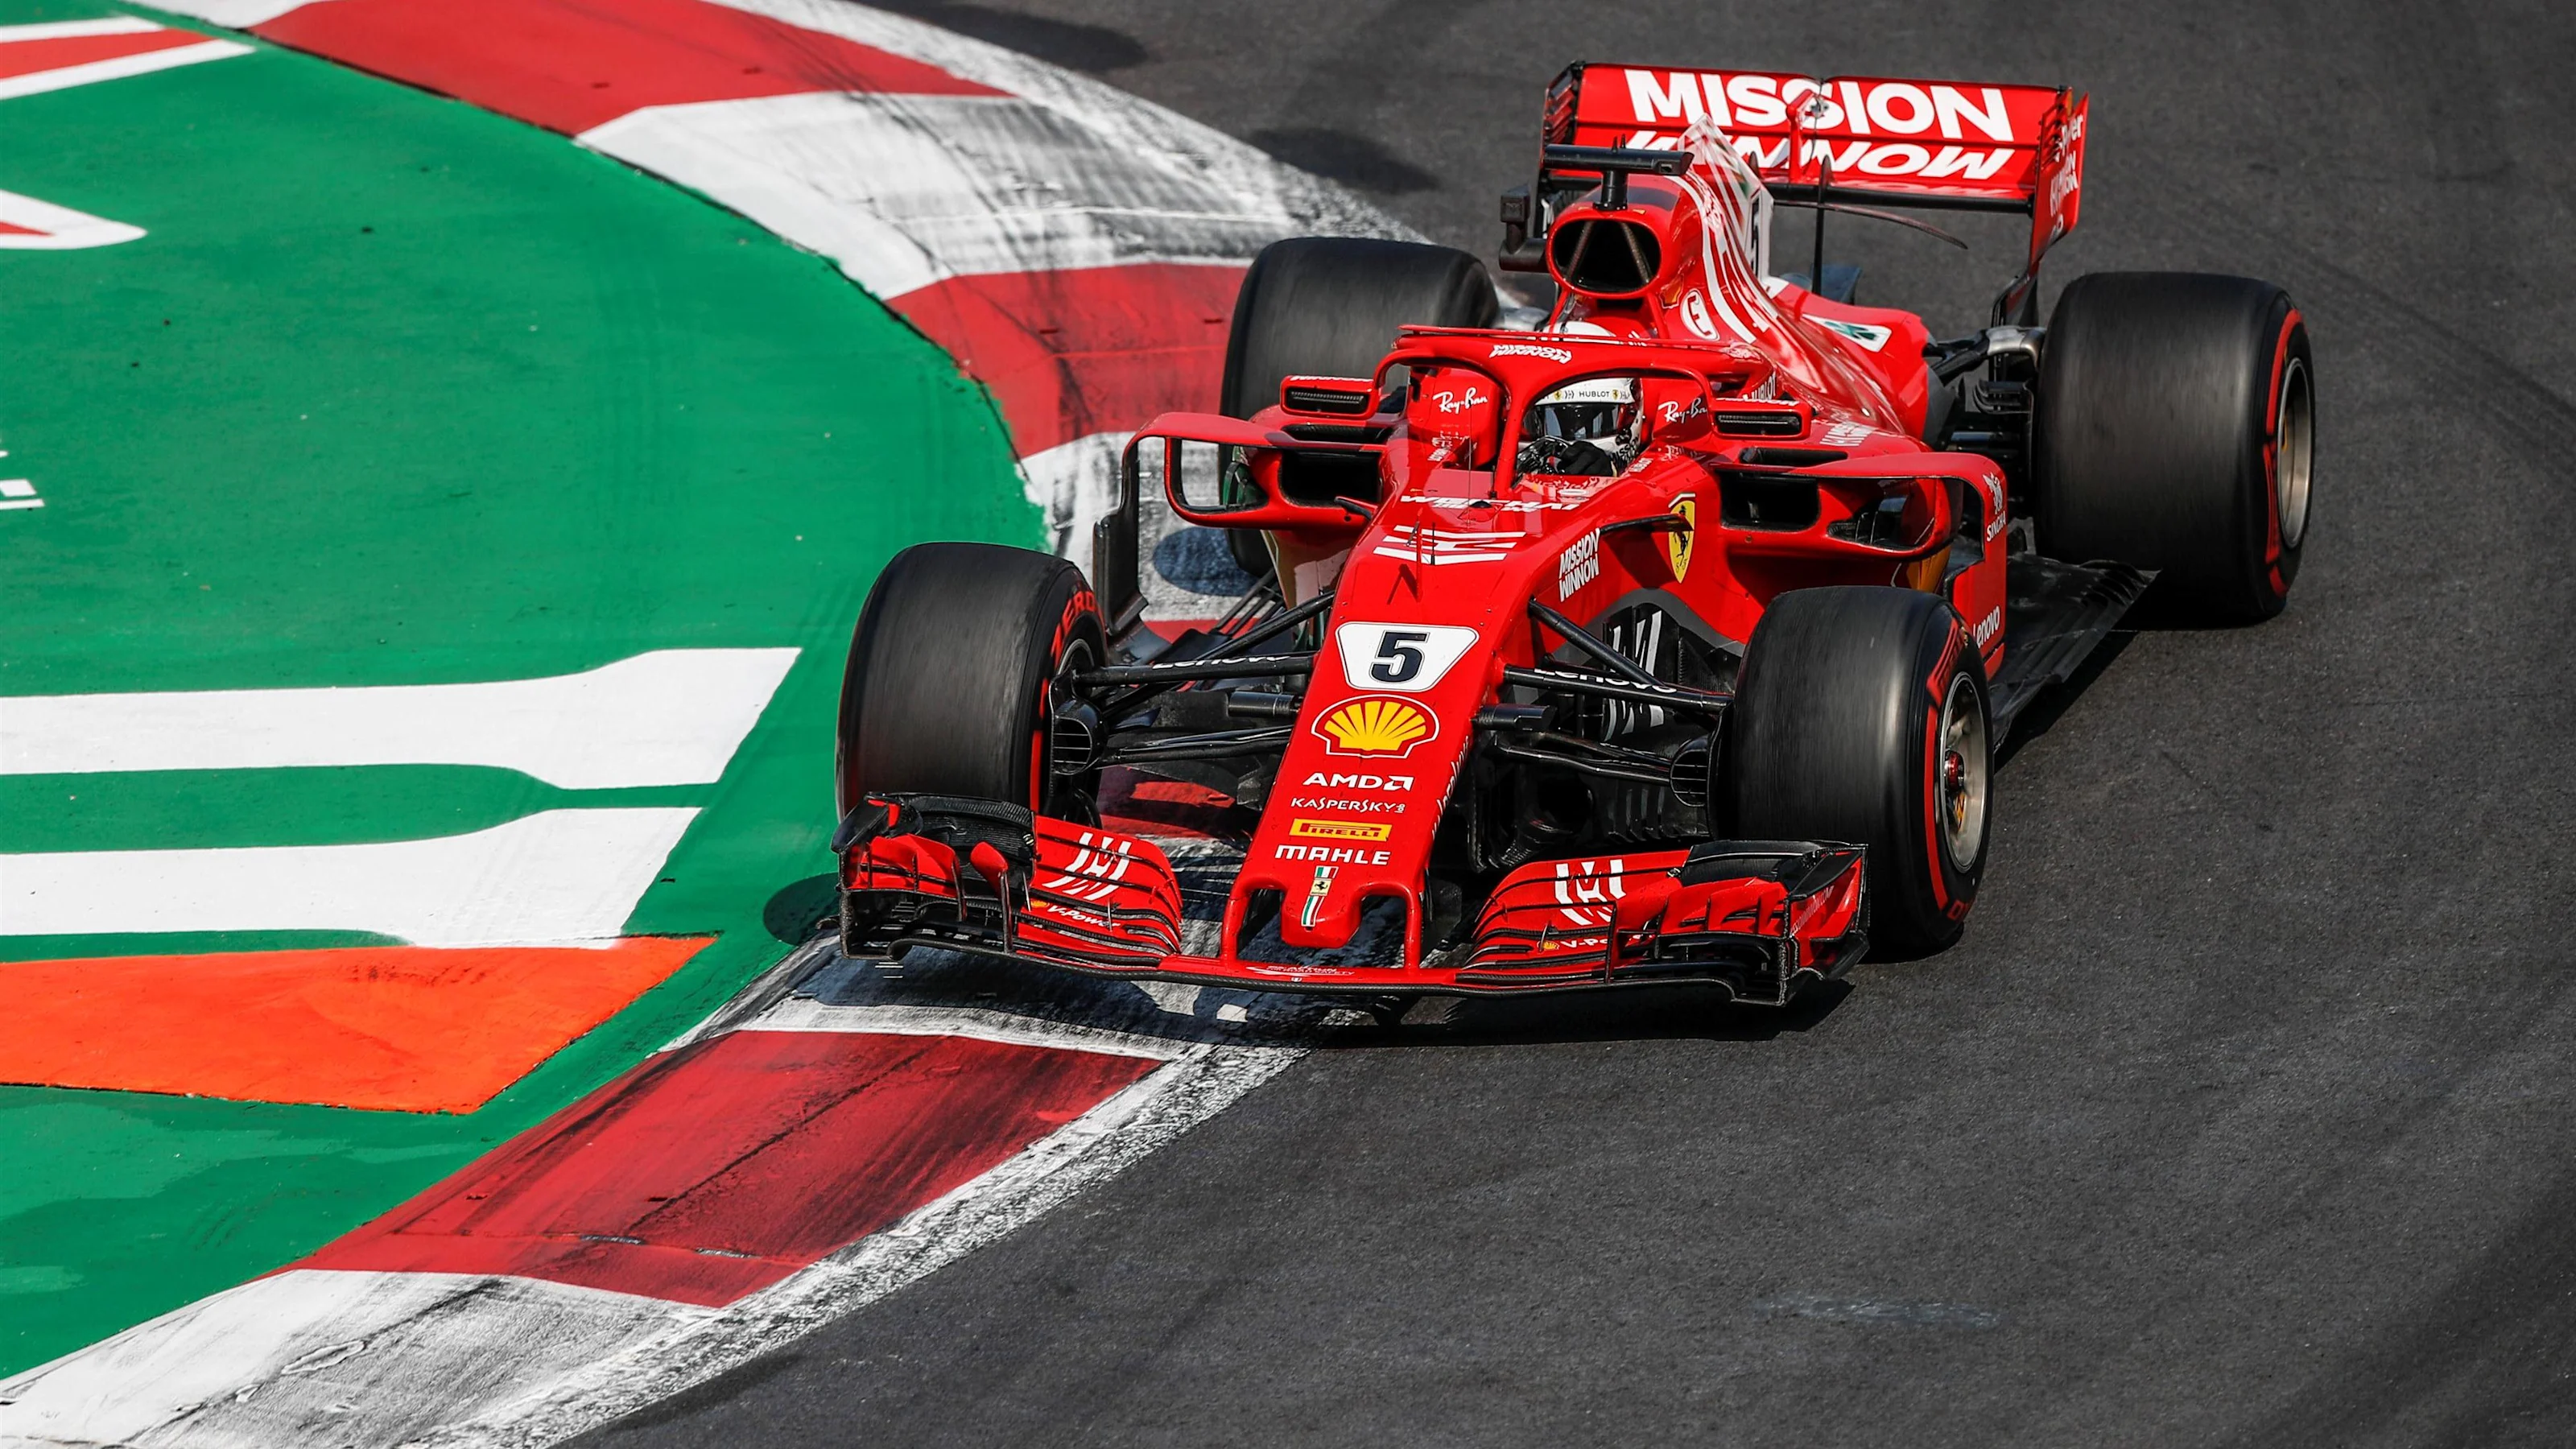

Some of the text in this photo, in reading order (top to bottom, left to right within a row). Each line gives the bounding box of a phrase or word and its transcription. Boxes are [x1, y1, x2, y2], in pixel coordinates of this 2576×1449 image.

[1624, 69, 2014, 142] MISSION
[1432, 387, 1488, 414] Ray-Ban
[1658, 398, 1707, 423] Ray-Ba
[1558, 527, 1601, 579] MISSION
[1558, 553, 1600, 602] WINNOW
[1370, 631, 1429, 683] 5
[1302, 772, 1383, 789] AMD
[1290, 797, 1397, 813] KASPERSKY
[1298, 822, 1382, 838] PIRELLI
[1274, 844, 1391, 865] MAHLE
